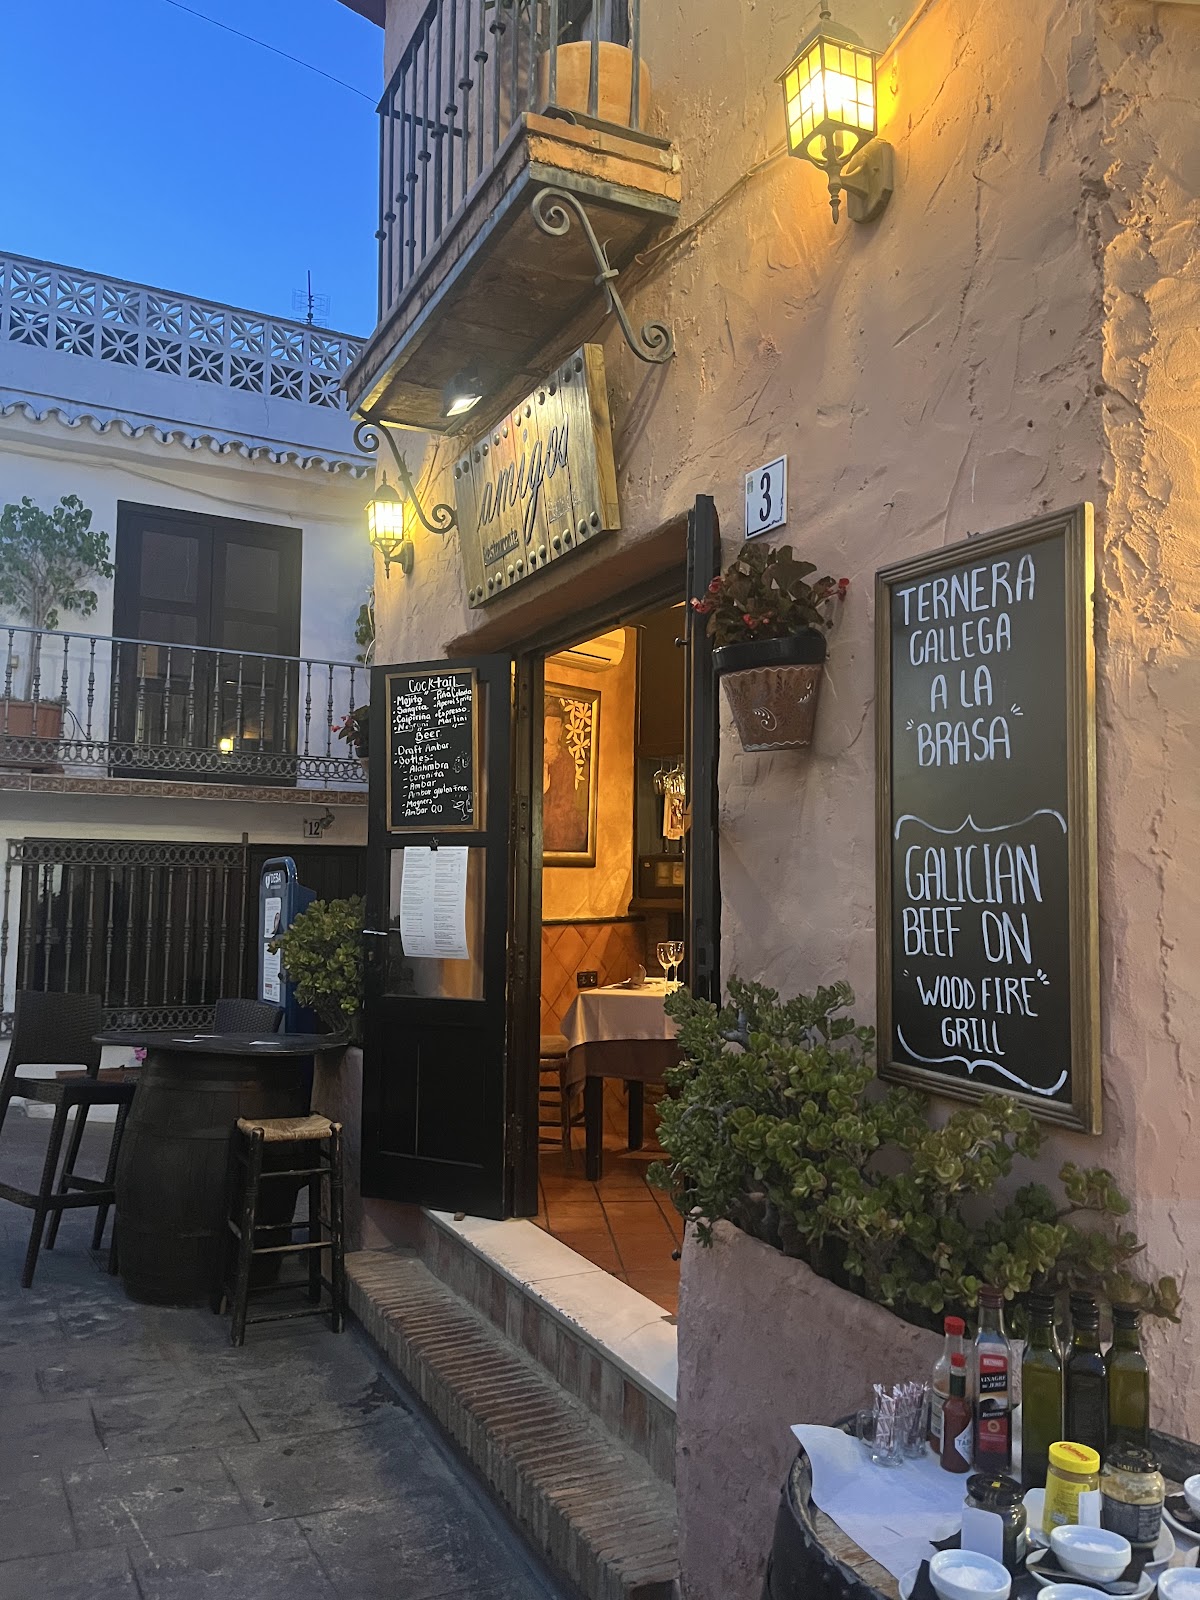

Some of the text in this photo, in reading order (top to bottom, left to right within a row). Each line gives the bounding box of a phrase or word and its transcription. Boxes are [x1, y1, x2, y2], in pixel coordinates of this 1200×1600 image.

[760, 472, 772, 522] 3
[896, 554, 1036, 626] TERNERA
[909, 613, 1011, 666] GALLEGA
[396, 695, 423, 707] Mojito
[408, 676, 457, 693] Cocktail
[930, 664, 993, 712] A LA
[437, 715, 467, 725] Martini
[397, 745, 423, 755] Draft
[409, 780, 437, 790] Ambar
[309, 821, 320, 836] 12
[905, 842, 1043, 904] GALICIAN
[902, 906, 1032, 965] BEEF ON
[941, 1016, 1006, 1056] GRILL
